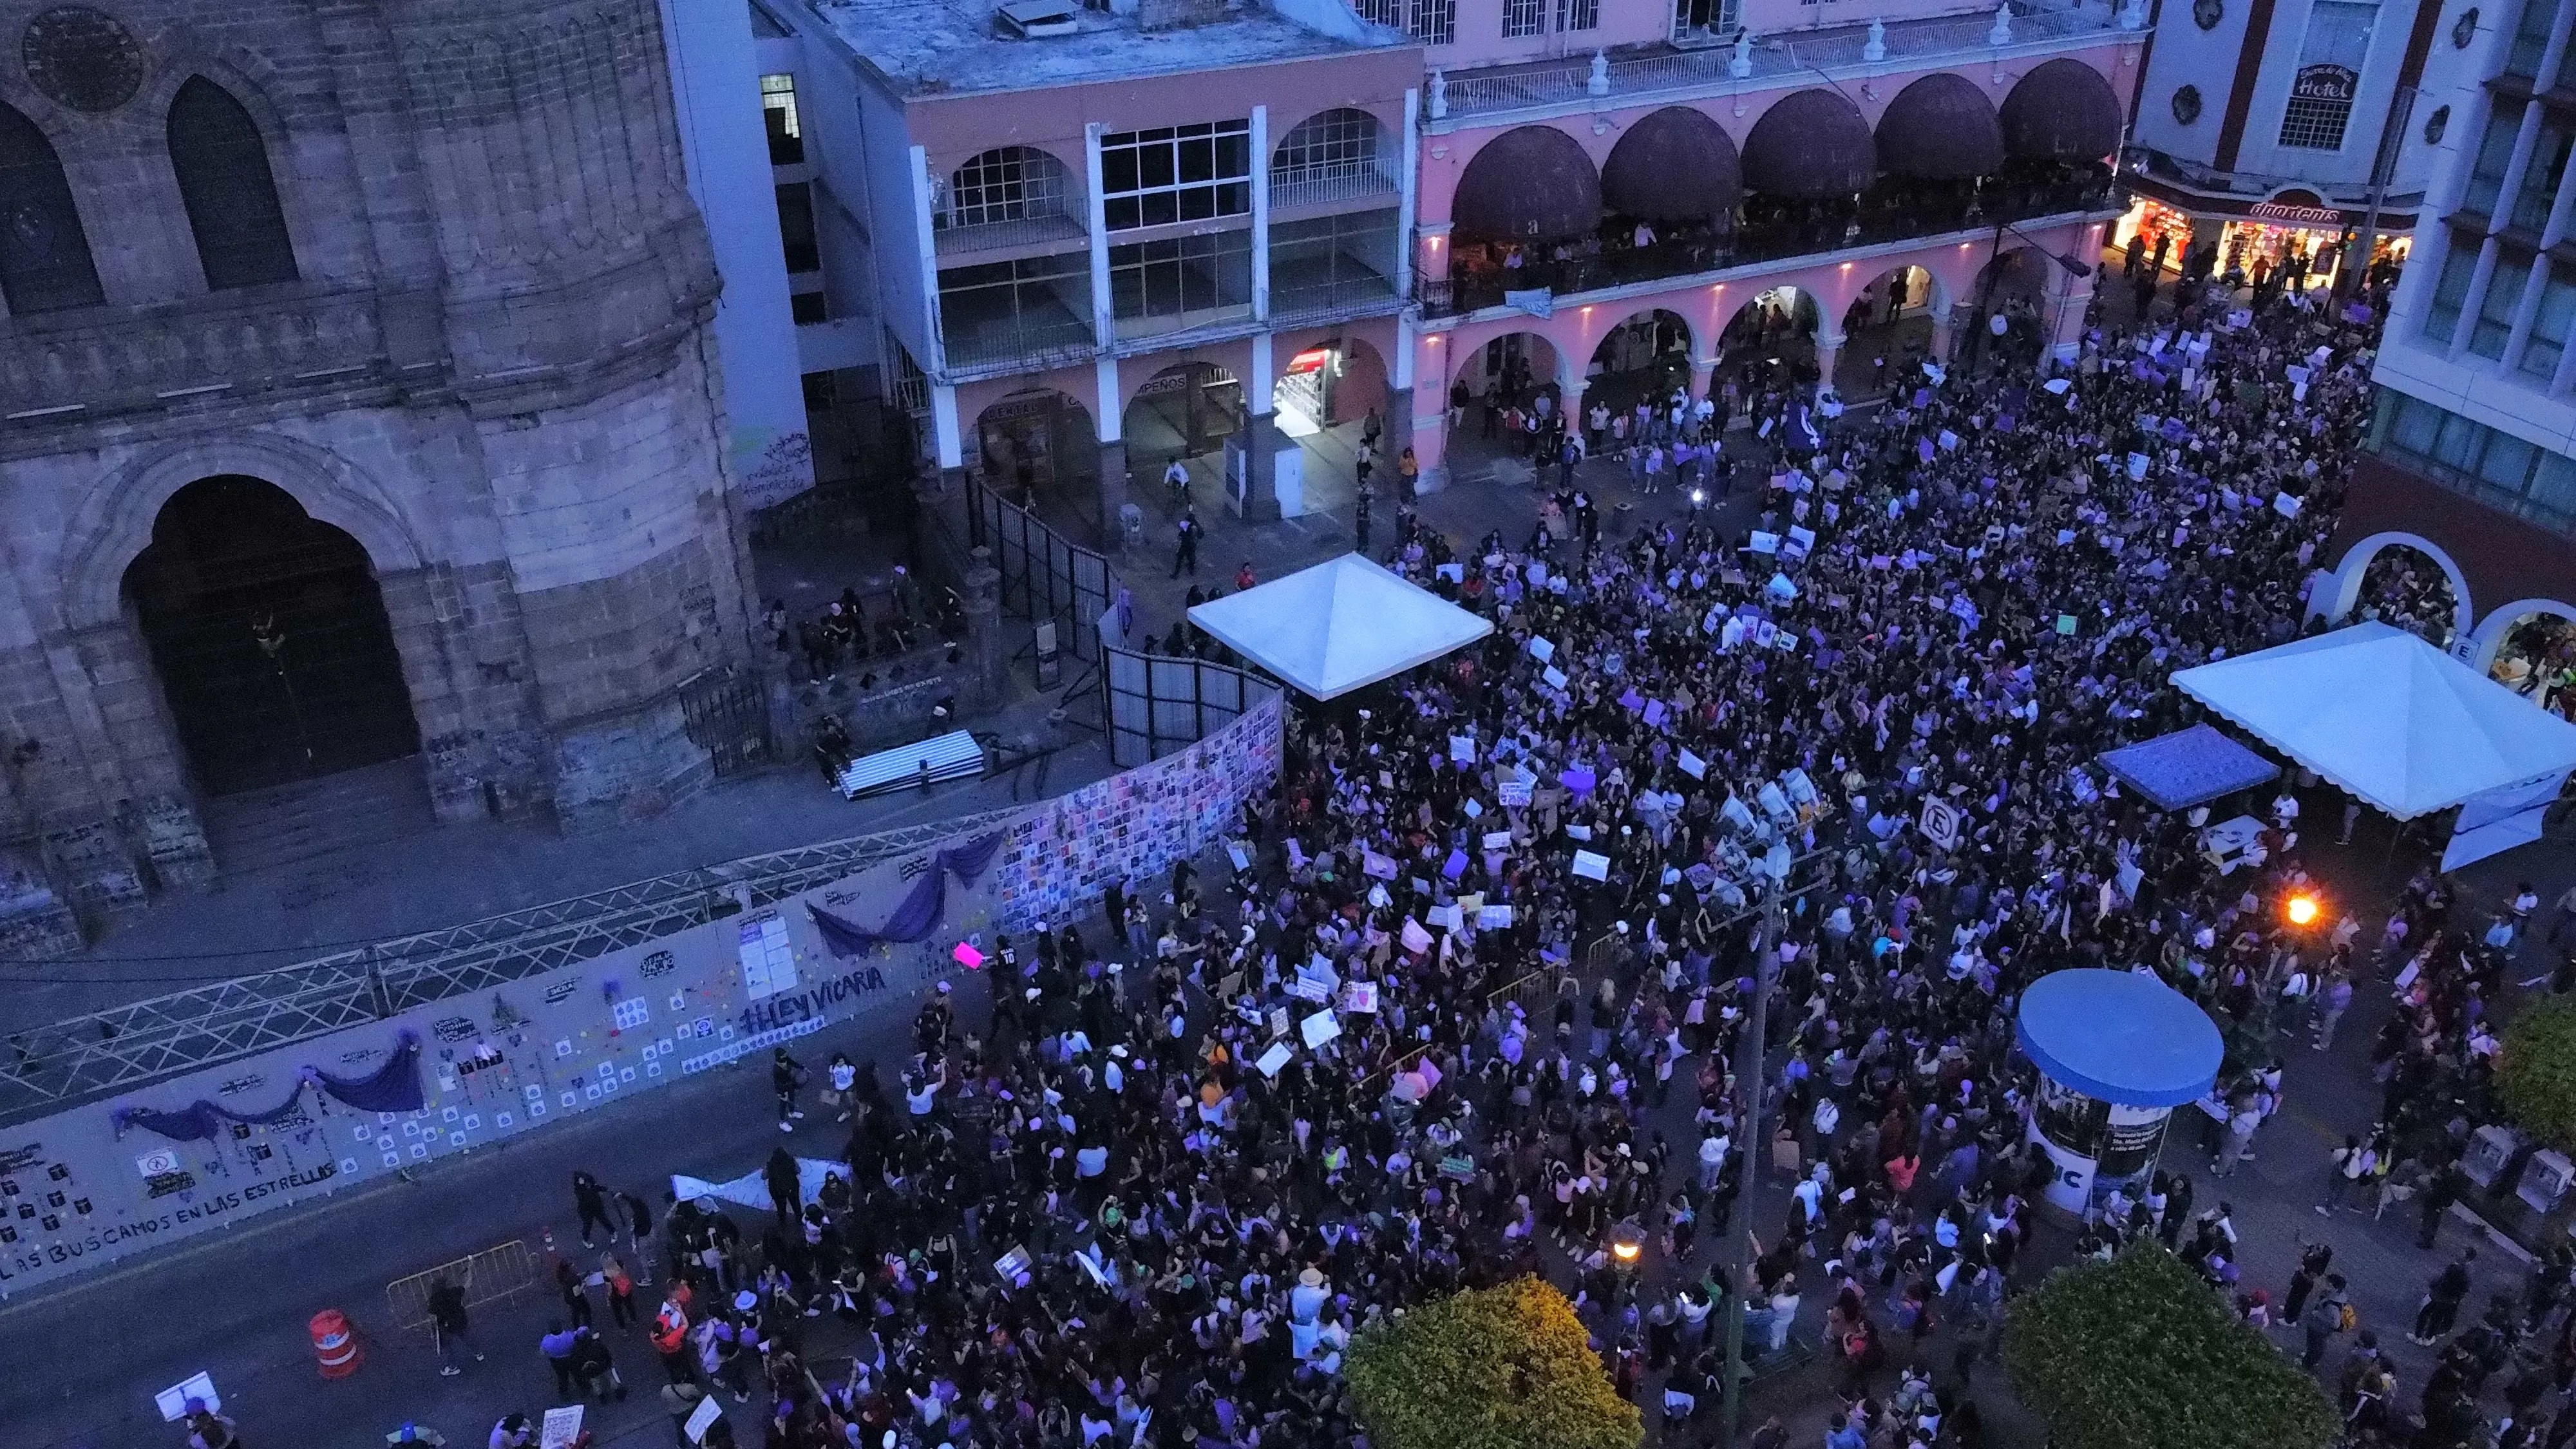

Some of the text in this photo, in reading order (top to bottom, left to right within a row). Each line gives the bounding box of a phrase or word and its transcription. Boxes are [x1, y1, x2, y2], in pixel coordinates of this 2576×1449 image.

[2298, 79, 2348, 98] Hotel
[2458, 645, 2470, 658] E
[1003, 953, 1014, 964] 10
[810, 967, 887, 1010] VICARIA
[176, 1206, 201, 1224] EN
[204, 1193, 240, 1215] LAS
